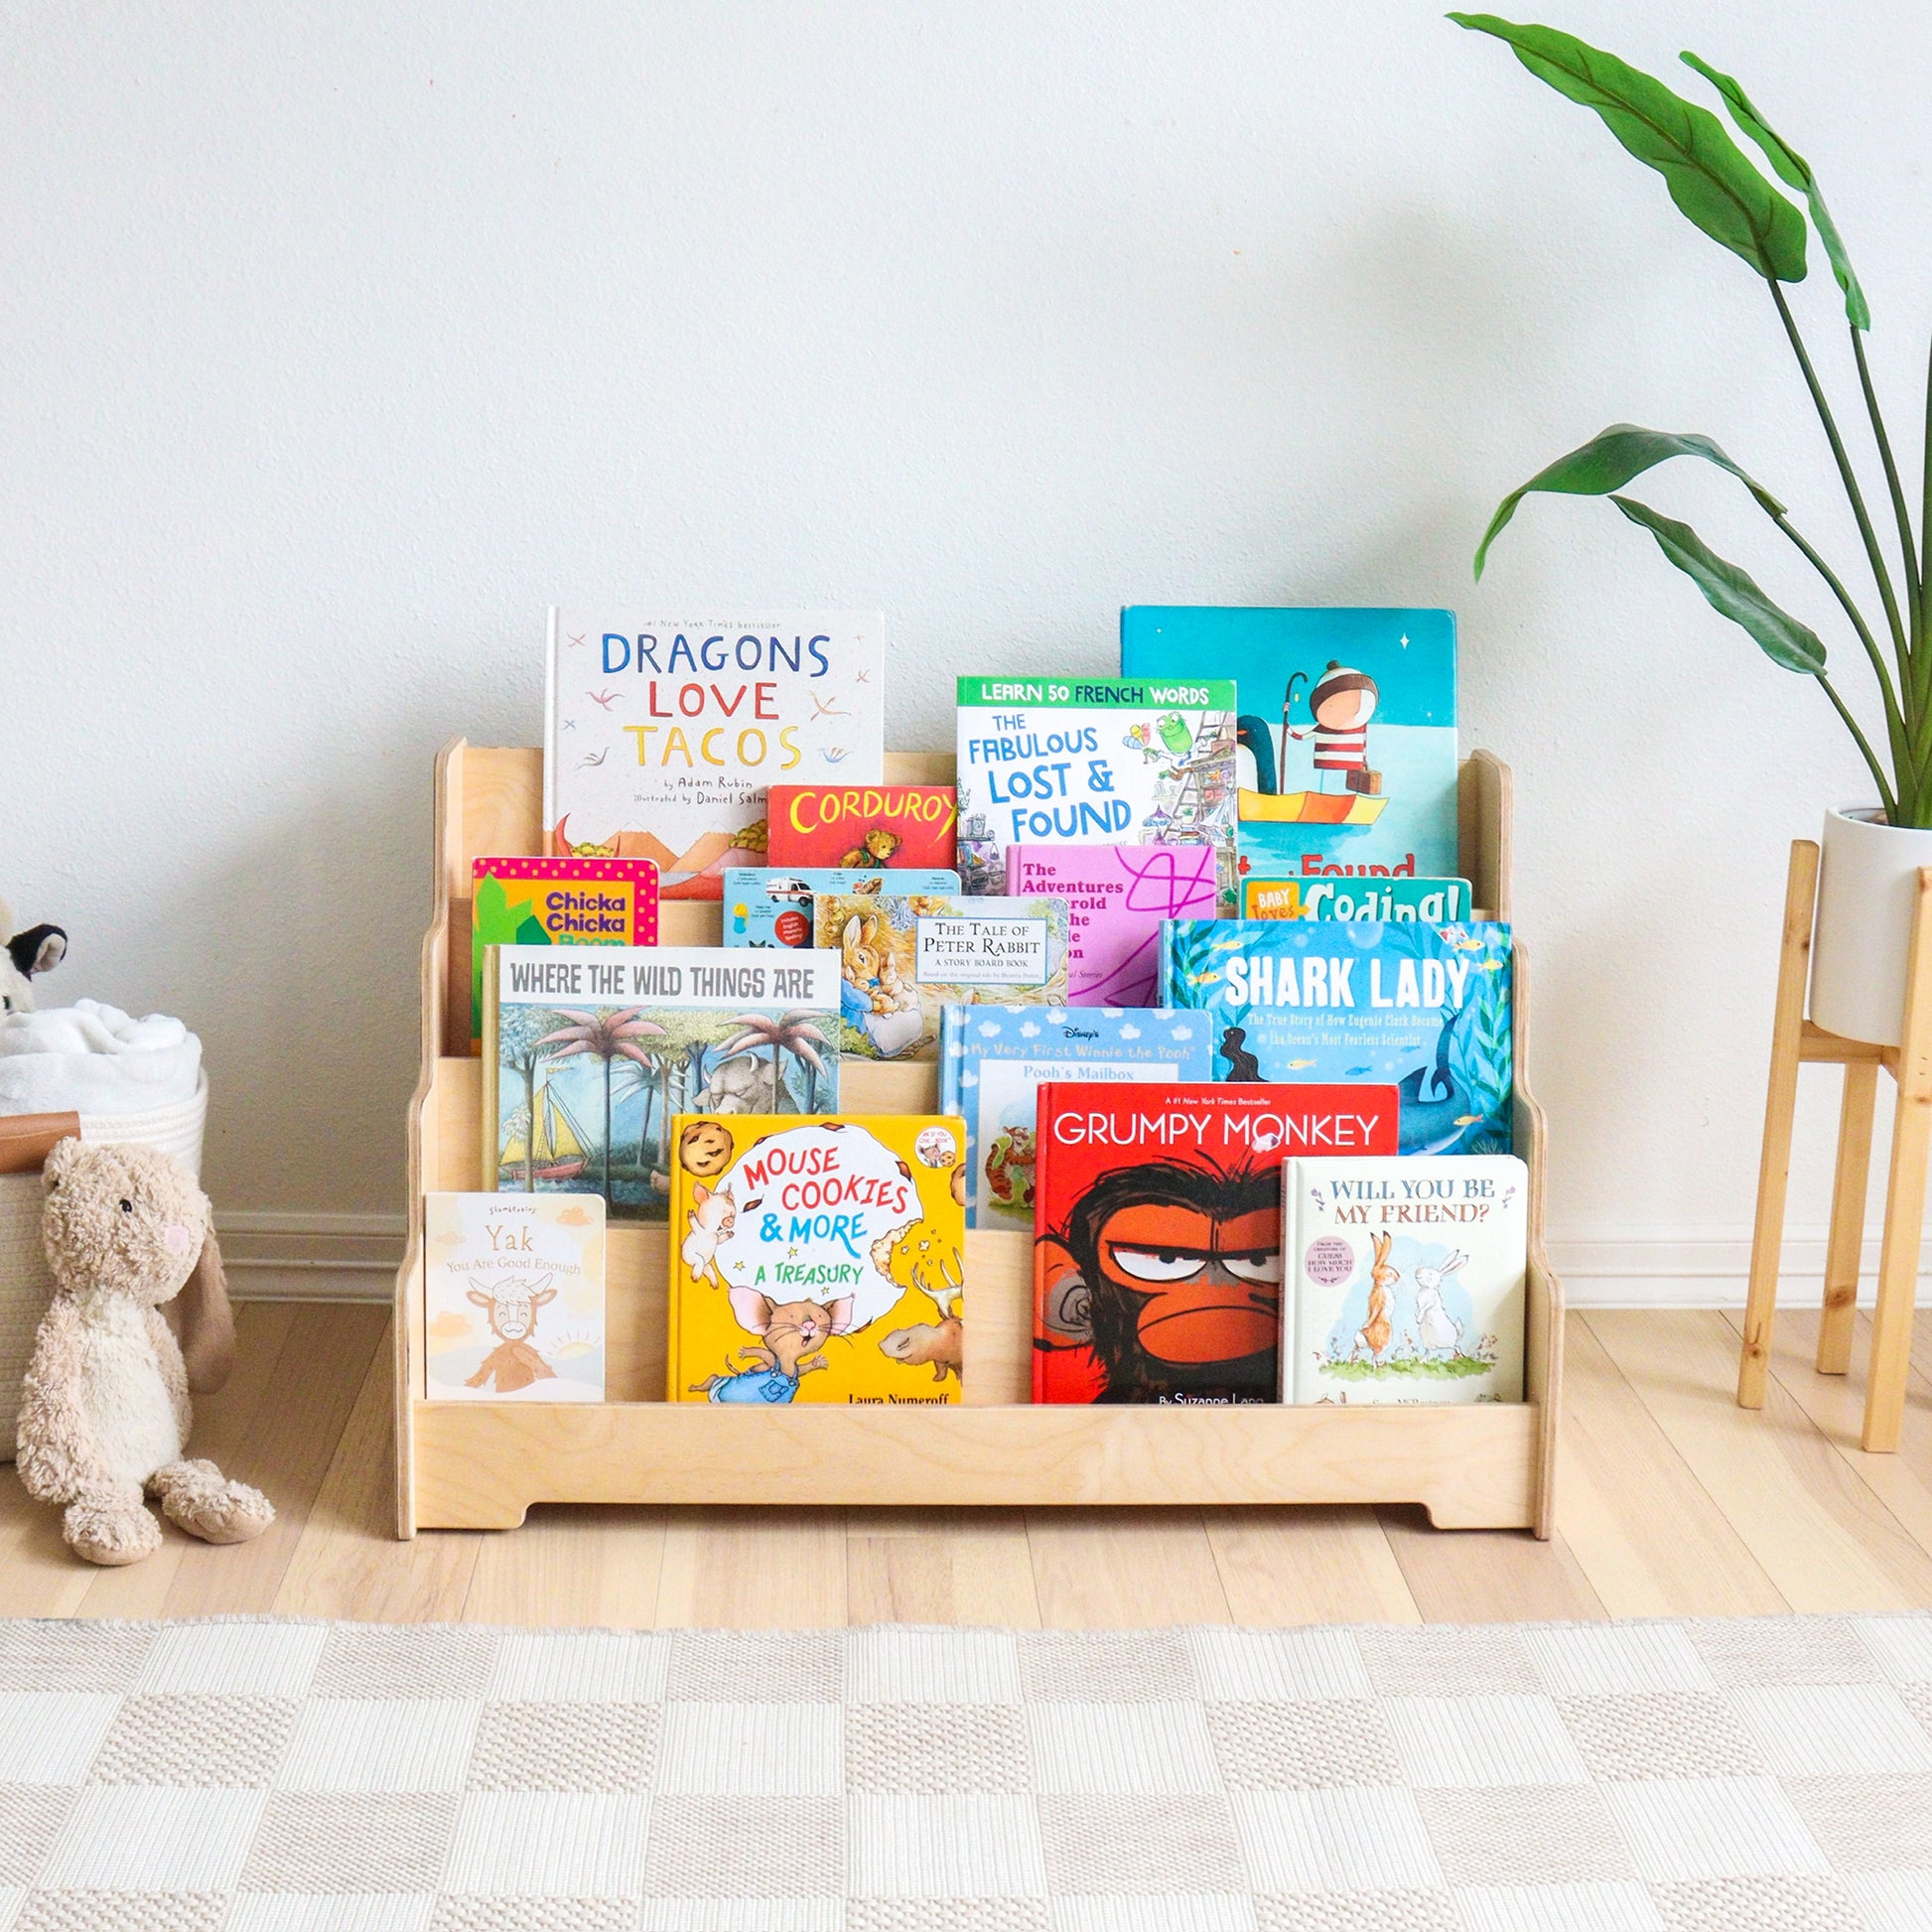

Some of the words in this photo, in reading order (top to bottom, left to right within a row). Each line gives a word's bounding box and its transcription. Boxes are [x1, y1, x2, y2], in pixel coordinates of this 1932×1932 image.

[602, 632, 831, 677] DRAGONS
[649, 681, 779, 720] LOVE
[982, 684, 1042, 702] LEARN
[1048, 685, 1070, 701] 50
[1075, 686, 1144, 704] FRENCH
[1149, 686, 1209, 705] WORDS
[992, 713, 1027, 731] THE
[622, 726, 802, 769] TACOS
[968, 727, 1098, 764] FABULOUS
[664, 778, 675, 790] by
[678, 777, 714, 788] Adam
[718, 776, 753, 789] Rubin
[988, 762, 1071, 804] LOST
[1088, 759, 1115, 793] &
[696, 792, 733, 805] Daniel
[739, 792, 767, 805] Salm
[789, 790, 958, 849] CORDUROY
[1012, 799, 1132, 843] FOUND
[1023, 863, 1056, 878] The
[1022, 881, 1124, 895] Adventures
[1258, 888, 1291, 908] BABY
[546, 891, 625, 912] Chicka
[1069, 897, 1108, 910] rold
[546, 913, 625, 933] Chicka
[1069, 913, 1090, 926] he
[923, 937, 975, 953] PETER
[983, 938, 1040, 957] RABBIT
[974, 959, 1004, 968] BOARD
[1006, 959, 1029, 968] BOOK
[510, 962, 582, 994] WHERE
[588, 964, 625, 995] THE
[633, 965, 682, 997] WILD
[690, 967, 765, 999] THINGS
[773, 969, 815, 1000] ARE
[1225, 955, 1355, 1008] SHARK
[1370, 958, 1471, 1010] LADY
[1248, 1014, 1263, 1026] The
[1266, 1014, 1288, 1026] True
[1290, 1014, 1313, 1029] Story
[1315, 1014, 1324, 1026] of
[1327, 1015, 1345, 1026] How
[1348, 1015, 1382, 1030] Eugenie
[1385, 1015, 1408, 1027] Clark
[1411, 1015, 1444, 1027] Became
[1061, 1026, 1100, 1041] Disney's
[1287, 1033, 1319, 1045] Ocean's
[1321, 1034, 1341, 1045] Most
[1344, 1034, 1379, 1045] Fearless
[1382, 1035, 1421, 1046] Scientist
[971, 1043, 990, 1058] My
[994, 1043, 1027, 1058] Very
[1033, 1044, 1071, 1057] First
[1075, 1044, 1123, 1058] Winnie
[1128, 1045, 1152, 1058] the
[1024, 1065, 1072, 1079] Pooh's
[1077, 1066, 1134, 1080] Mailbox
[1053, 1112, 1212, 1146] GRUMPY
[1223, 1113, 1379, 1147] MONKEY
[743, 1147, 840, 1190] MOUSE
[781, 1174, 908, 1214] COOKIES
[1330, 1179, 1395, 1199] WILL
[1400, 1179, 1453, 1199] YOU
[1462, 1178, 1495, 1198] BE
[1334, 1204, 1374, 1224] MY
[1379, 1203, 1490, 1224] FRIEND?
[484, 1225, 534, 1251] Yak
[759, 1212, 783, 1243] &
[788, 1212, 868, 1259] MORE
[447, 1261, 469, 1273] You
[473, 1259, 494, 1269] Are
[497, 1257, 531, 1269] Good
[535, 1258, 581, 1276] Enough
[755, 1265, 766, 1286] A
[774, 1262, 865, 1286] TREASURY
[849, 1393, 884, 1404] Laura
[889, 1393, 949, 1404] Numeroff
[1174, 1392, 1229, 1405] Suzanne
